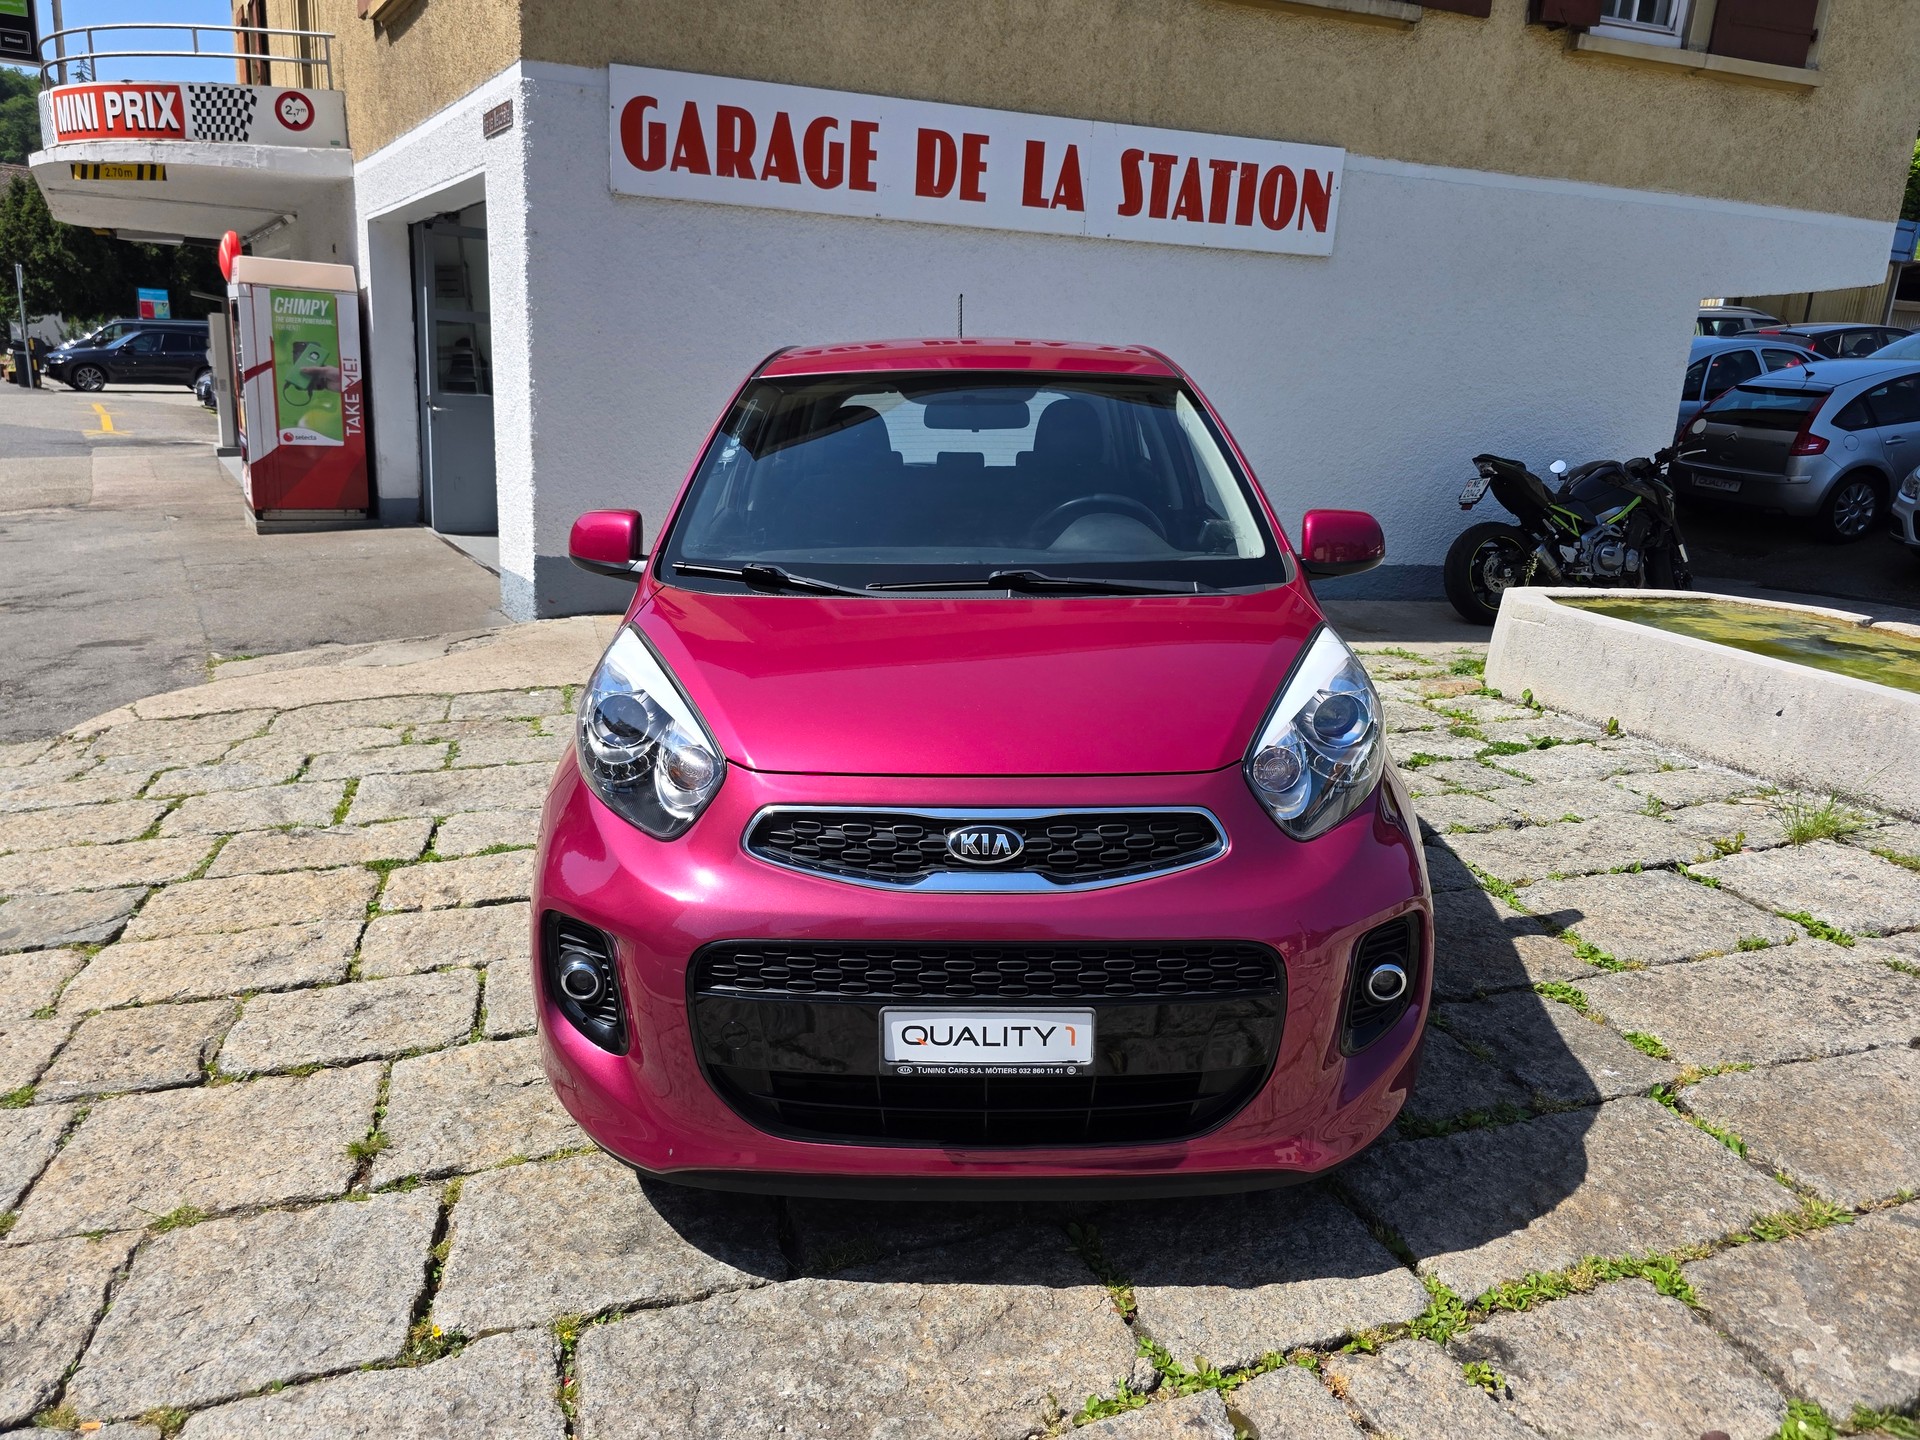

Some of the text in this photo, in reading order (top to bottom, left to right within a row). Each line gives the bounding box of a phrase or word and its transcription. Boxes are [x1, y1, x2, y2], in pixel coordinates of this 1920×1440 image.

[56, 91, 180, 133] MINI PRIX
[620, 95, 1335, 233] GARAGE DE LA STATION
[274, 296, 330, 316] CHIMPY
[343, 358, 361, 437] TAKE ME!
[295, 433, 317, 441] selecta
[960, 833, 1012, 855] KIA
[901, 1025, 1076, 1047] QUALITY 1
[916, 1066, 946, 1074] TUNING
[948, 1066, 968, 1074] CARS
[970, 1066, 984, 1074] S.A.
[985, 1066, 1017, 1074] MÔTIERS
